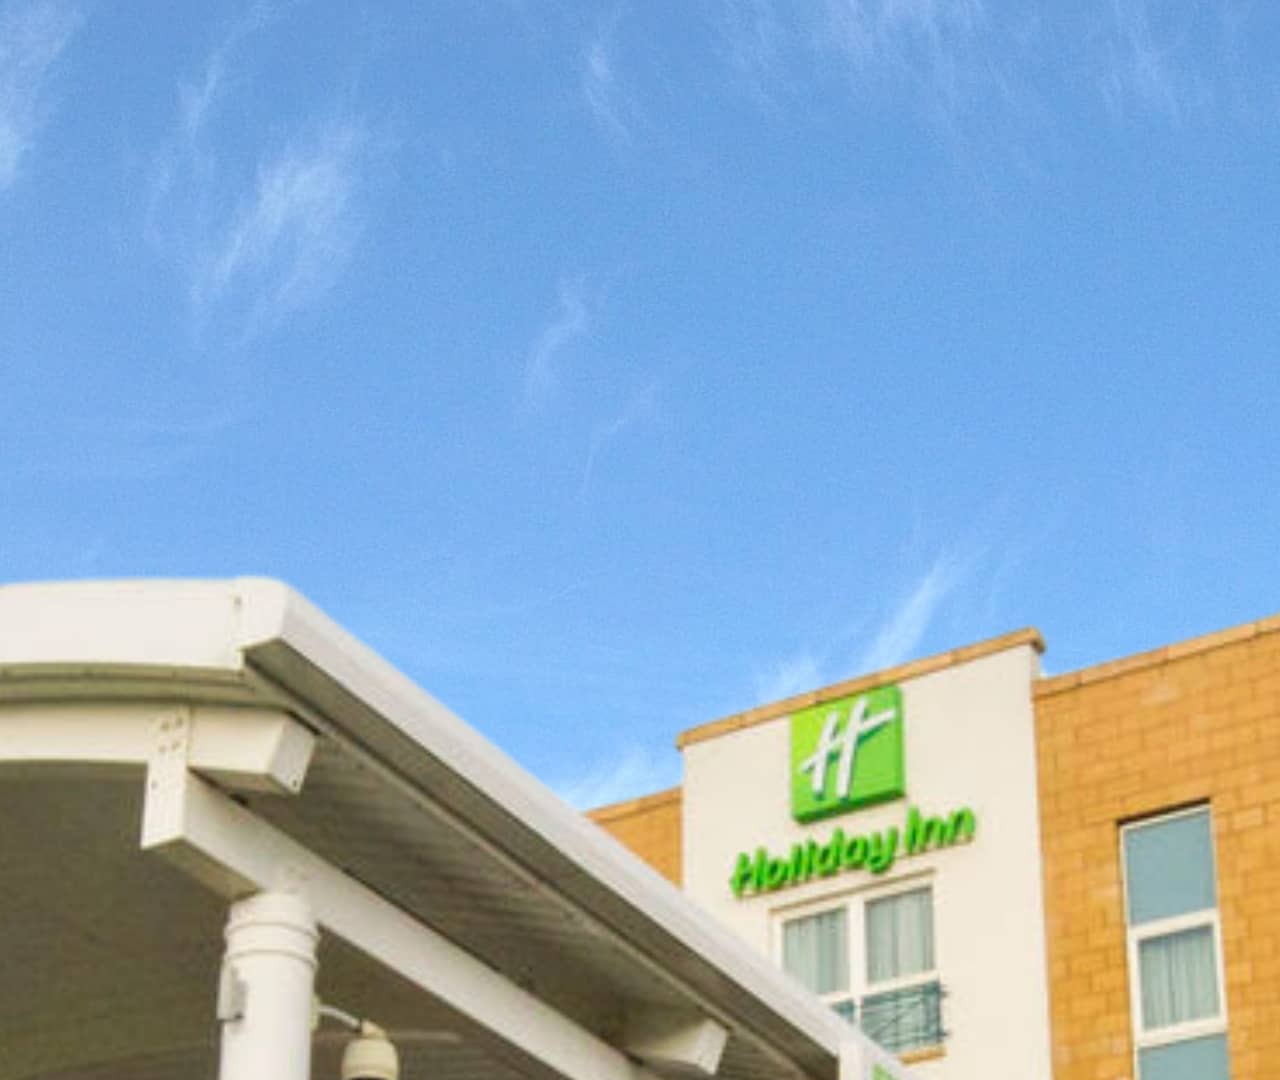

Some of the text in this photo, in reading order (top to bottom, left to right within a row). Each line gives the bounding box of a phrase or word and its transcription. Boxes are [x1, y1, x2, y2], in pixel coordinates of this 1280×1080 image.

[801, 699, 895, 797] H
[730, 806, 976, 897] Holiday Inn
